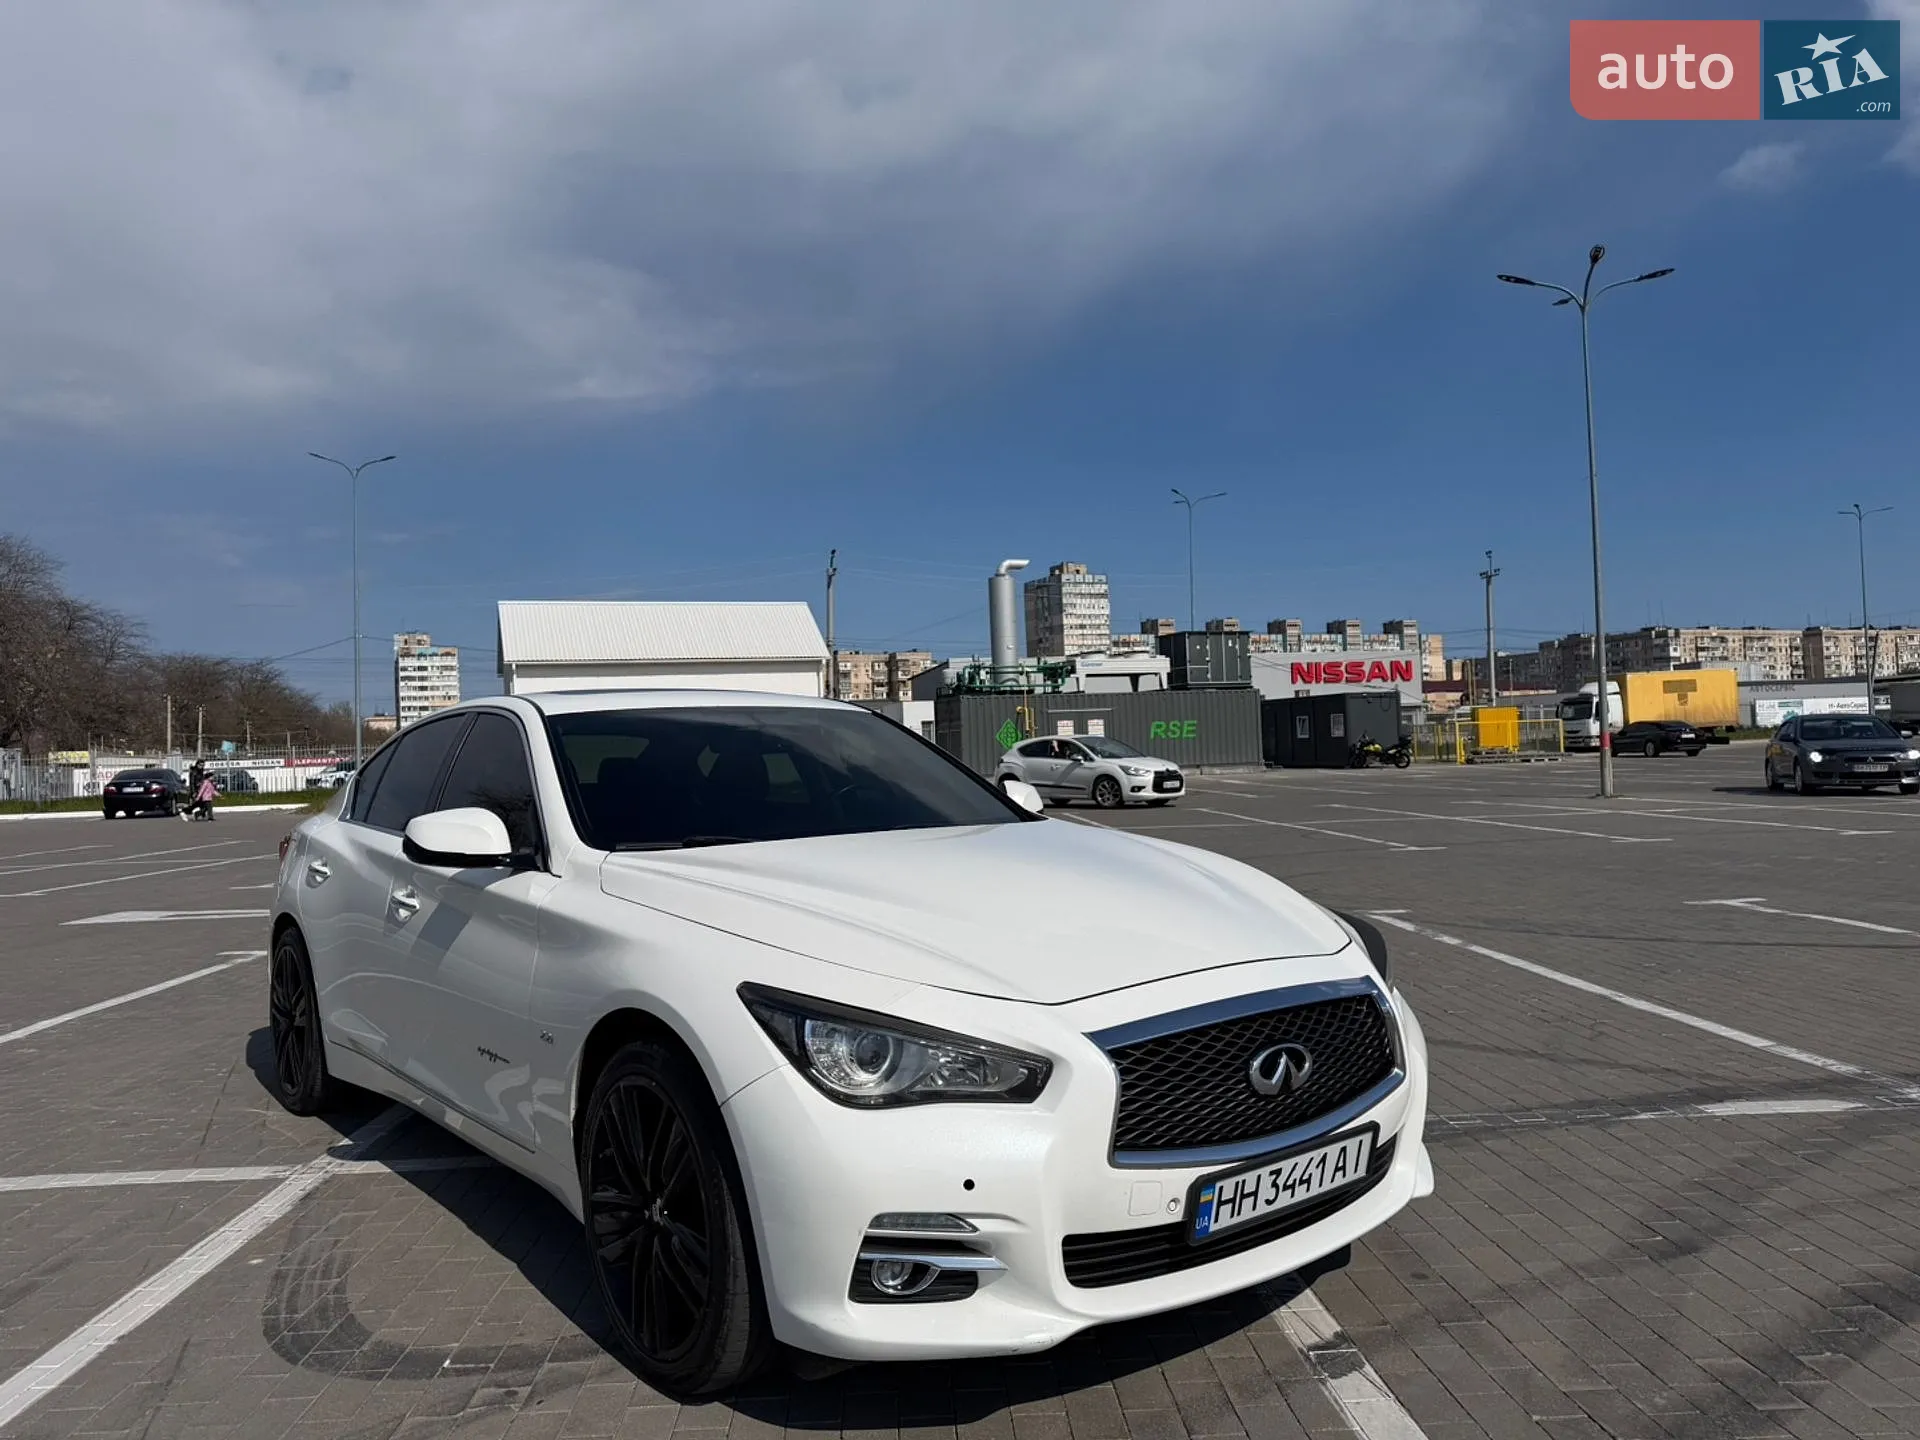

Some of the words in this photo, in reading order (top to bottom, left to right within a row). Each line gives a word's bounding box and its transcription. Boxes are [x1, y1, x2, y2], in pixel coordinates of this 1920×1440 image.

[1290, 659, 1414, 685] NISSAN
[1150, 719, 1197, 739] RSE
[1195, 1218, 1209, 1230] UA
